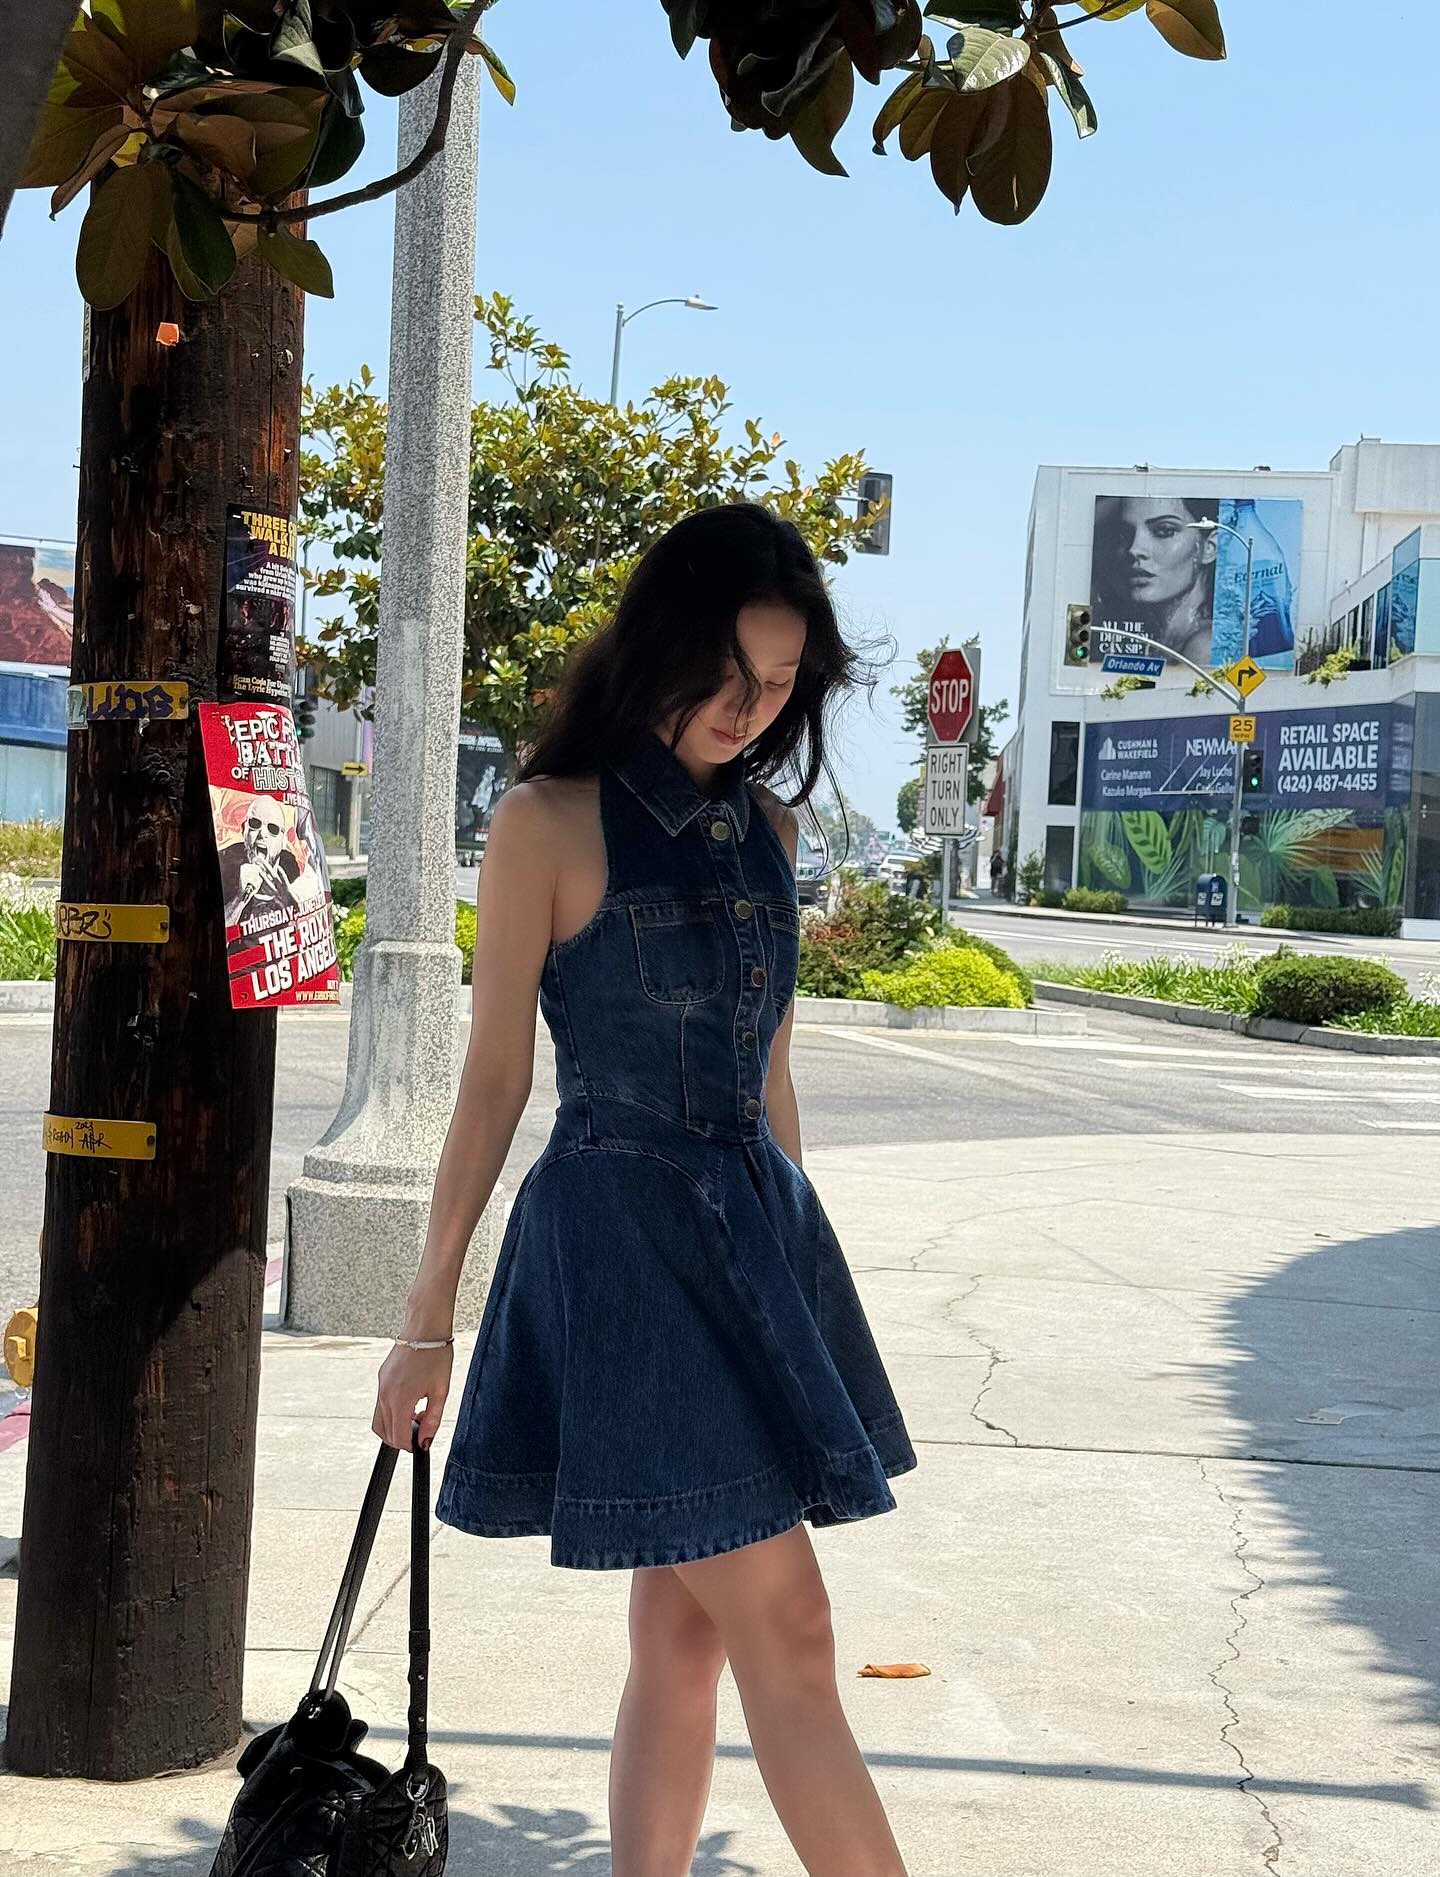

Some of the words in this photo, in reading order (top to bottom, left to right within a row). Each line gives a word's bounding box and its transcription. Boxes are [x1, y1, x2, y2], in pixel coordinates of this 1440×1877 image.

[241, 511, 288, 532] THREE
[250, 525, 289, 546] WALK
[268, 542, 279, 556] A
[243, 578, 257, 586] was
[248, 572, 262, 580] who
[235, 584, 265, 594] survived
[1123, 621, 1145, 632] THE
[1108, 659, 1146, 671] Orlando
[1147, 662, 1160, 672] Av
[233, 674, 250, 683] Scan
[251, 677, 266, 687] Code
[233, 682, 246, 690] The
[248, 683, 265, 693] Lyric
[930, 678, 970, 715] STOP
[234, 718, 280, 741] EPIC
[1233, 719, 1253, 732] 25
[1280, 724, 1329, 746] RETAIL
[1332, 721, 1380, 743] SPACE
[1117, 739, 1152, 750] CUSHMAN
[1117, 748, 1158, 760] WAKEFIELD
[930, 753, 963, 775] RIGHT
[1278, 744, 1378, 771] AVAILABLE
[931, 780, 960, 800] TURN
[1277, 774, 1312, 795] (424)
[1314, 773, 1377, 793] 487-4455
[930, 806, 960, 828] ONLY
[259, 926, 299, 963] THE
[250, 958, 293, 1001] LOS
